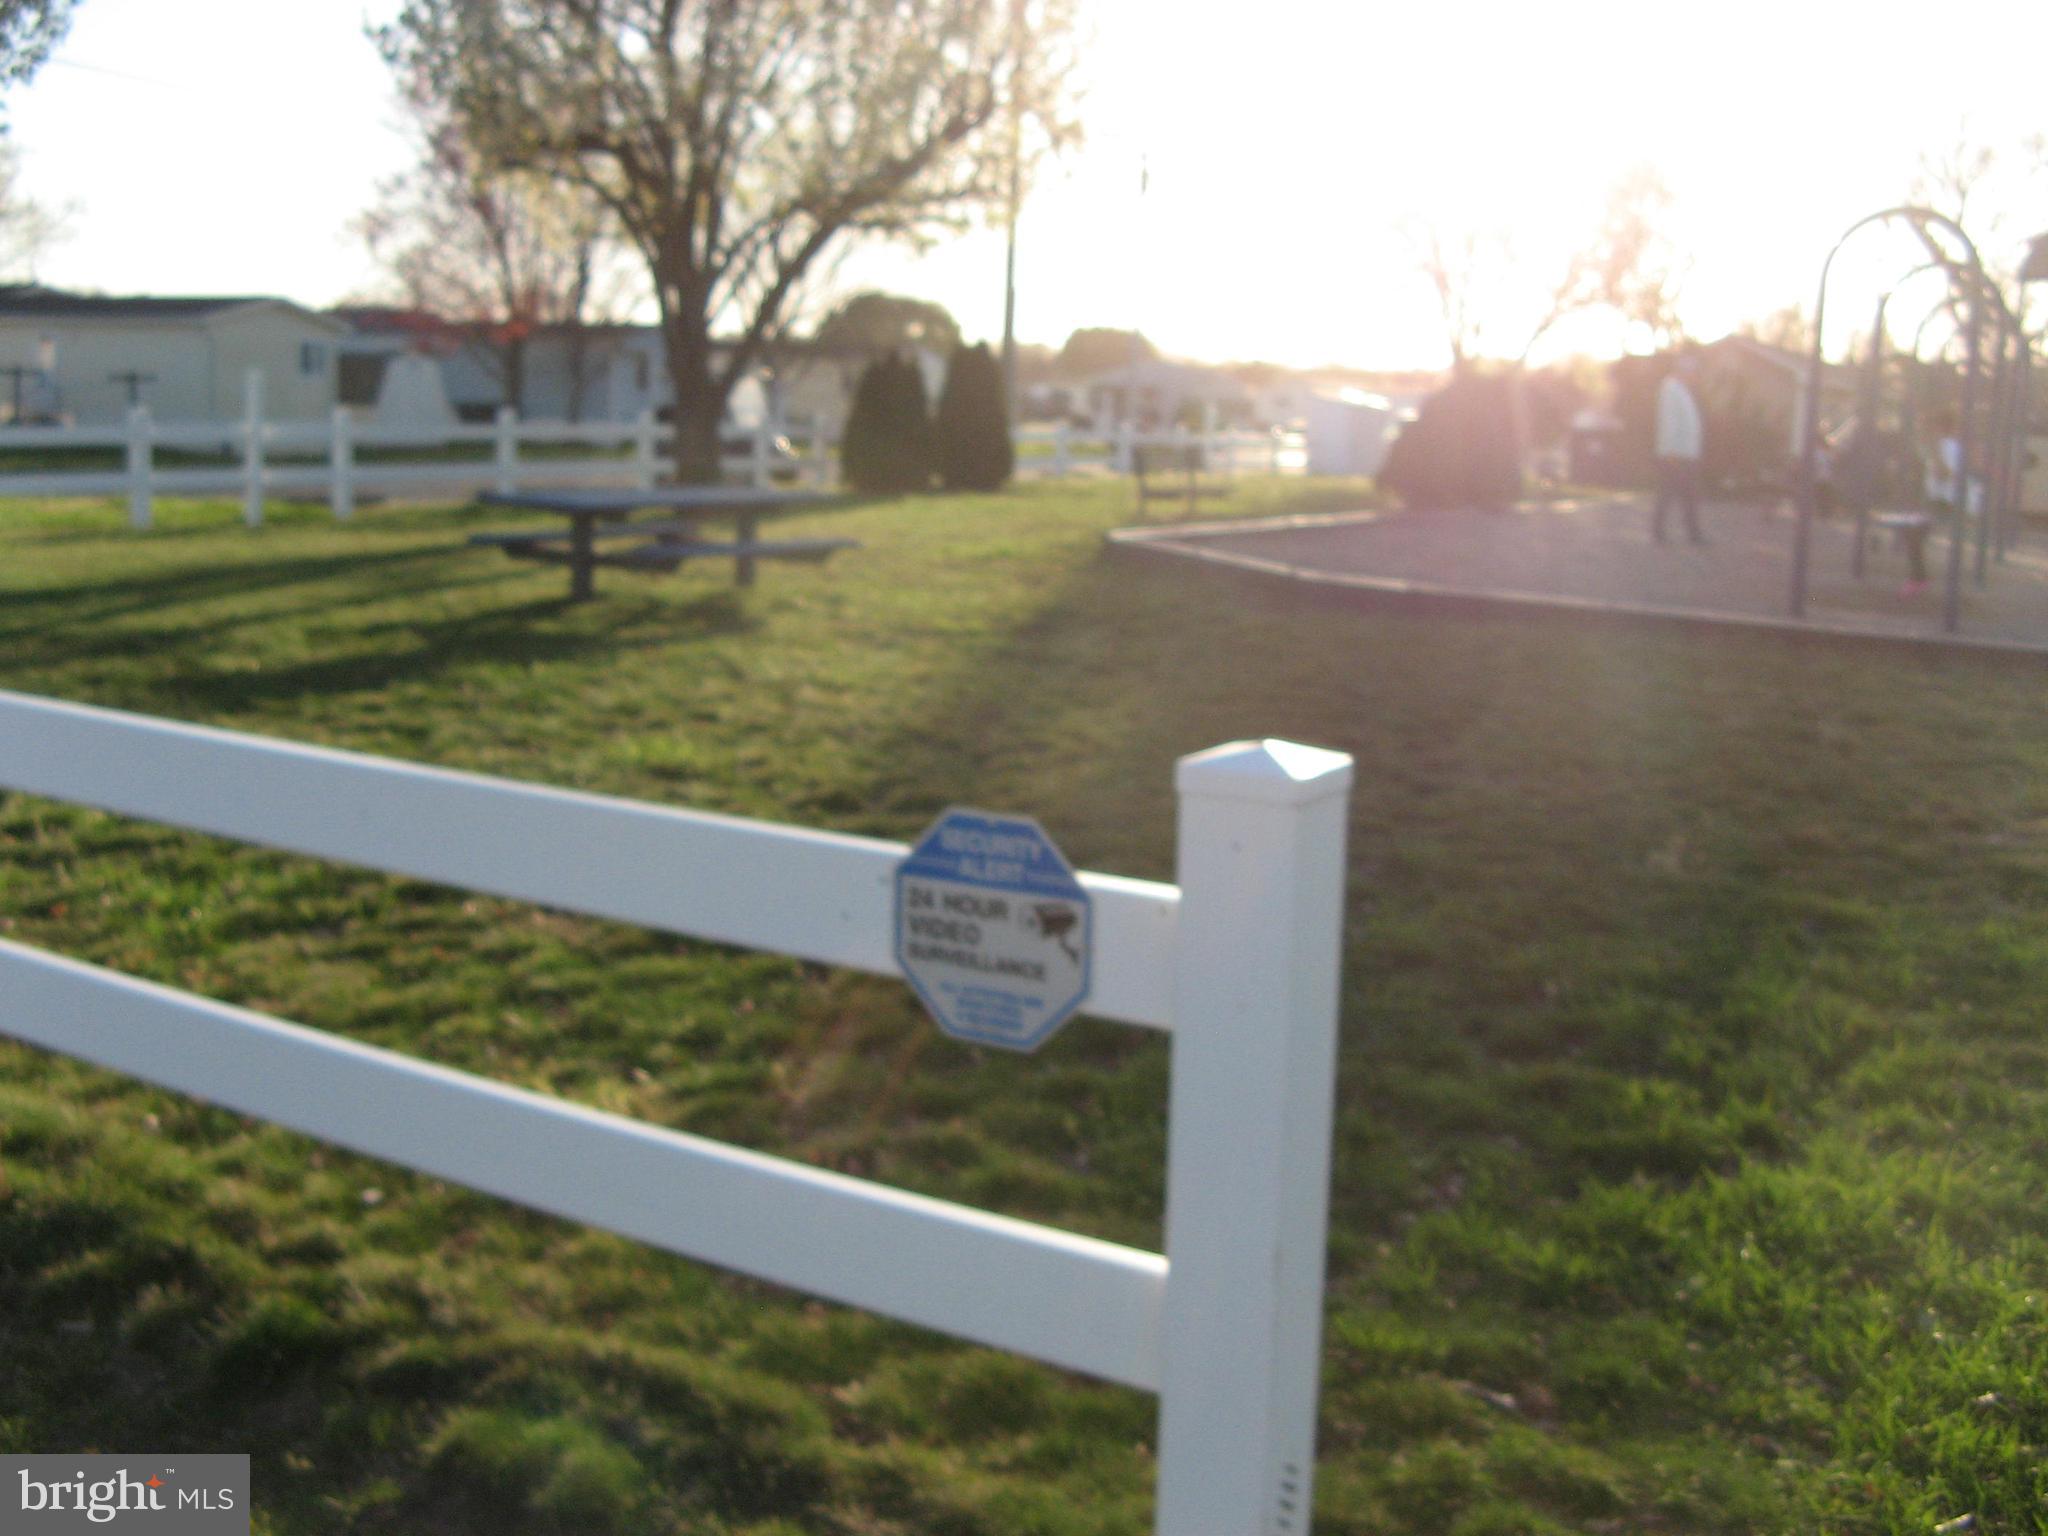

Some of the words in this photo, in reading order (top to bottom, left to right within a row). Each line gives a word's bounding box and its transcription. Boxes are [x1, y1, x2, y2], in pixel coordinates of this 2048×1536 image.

[941, 829, 1042, 861] SECURITY
[957, 859, 1025, 881] ALERT
[908, 886, 933, 908] 24
[942, 892, 1009, 919] HOUR
[908, 915, 980, 944] VIDEO
[907, 941, 1045, 981] SURVEILLANCE
